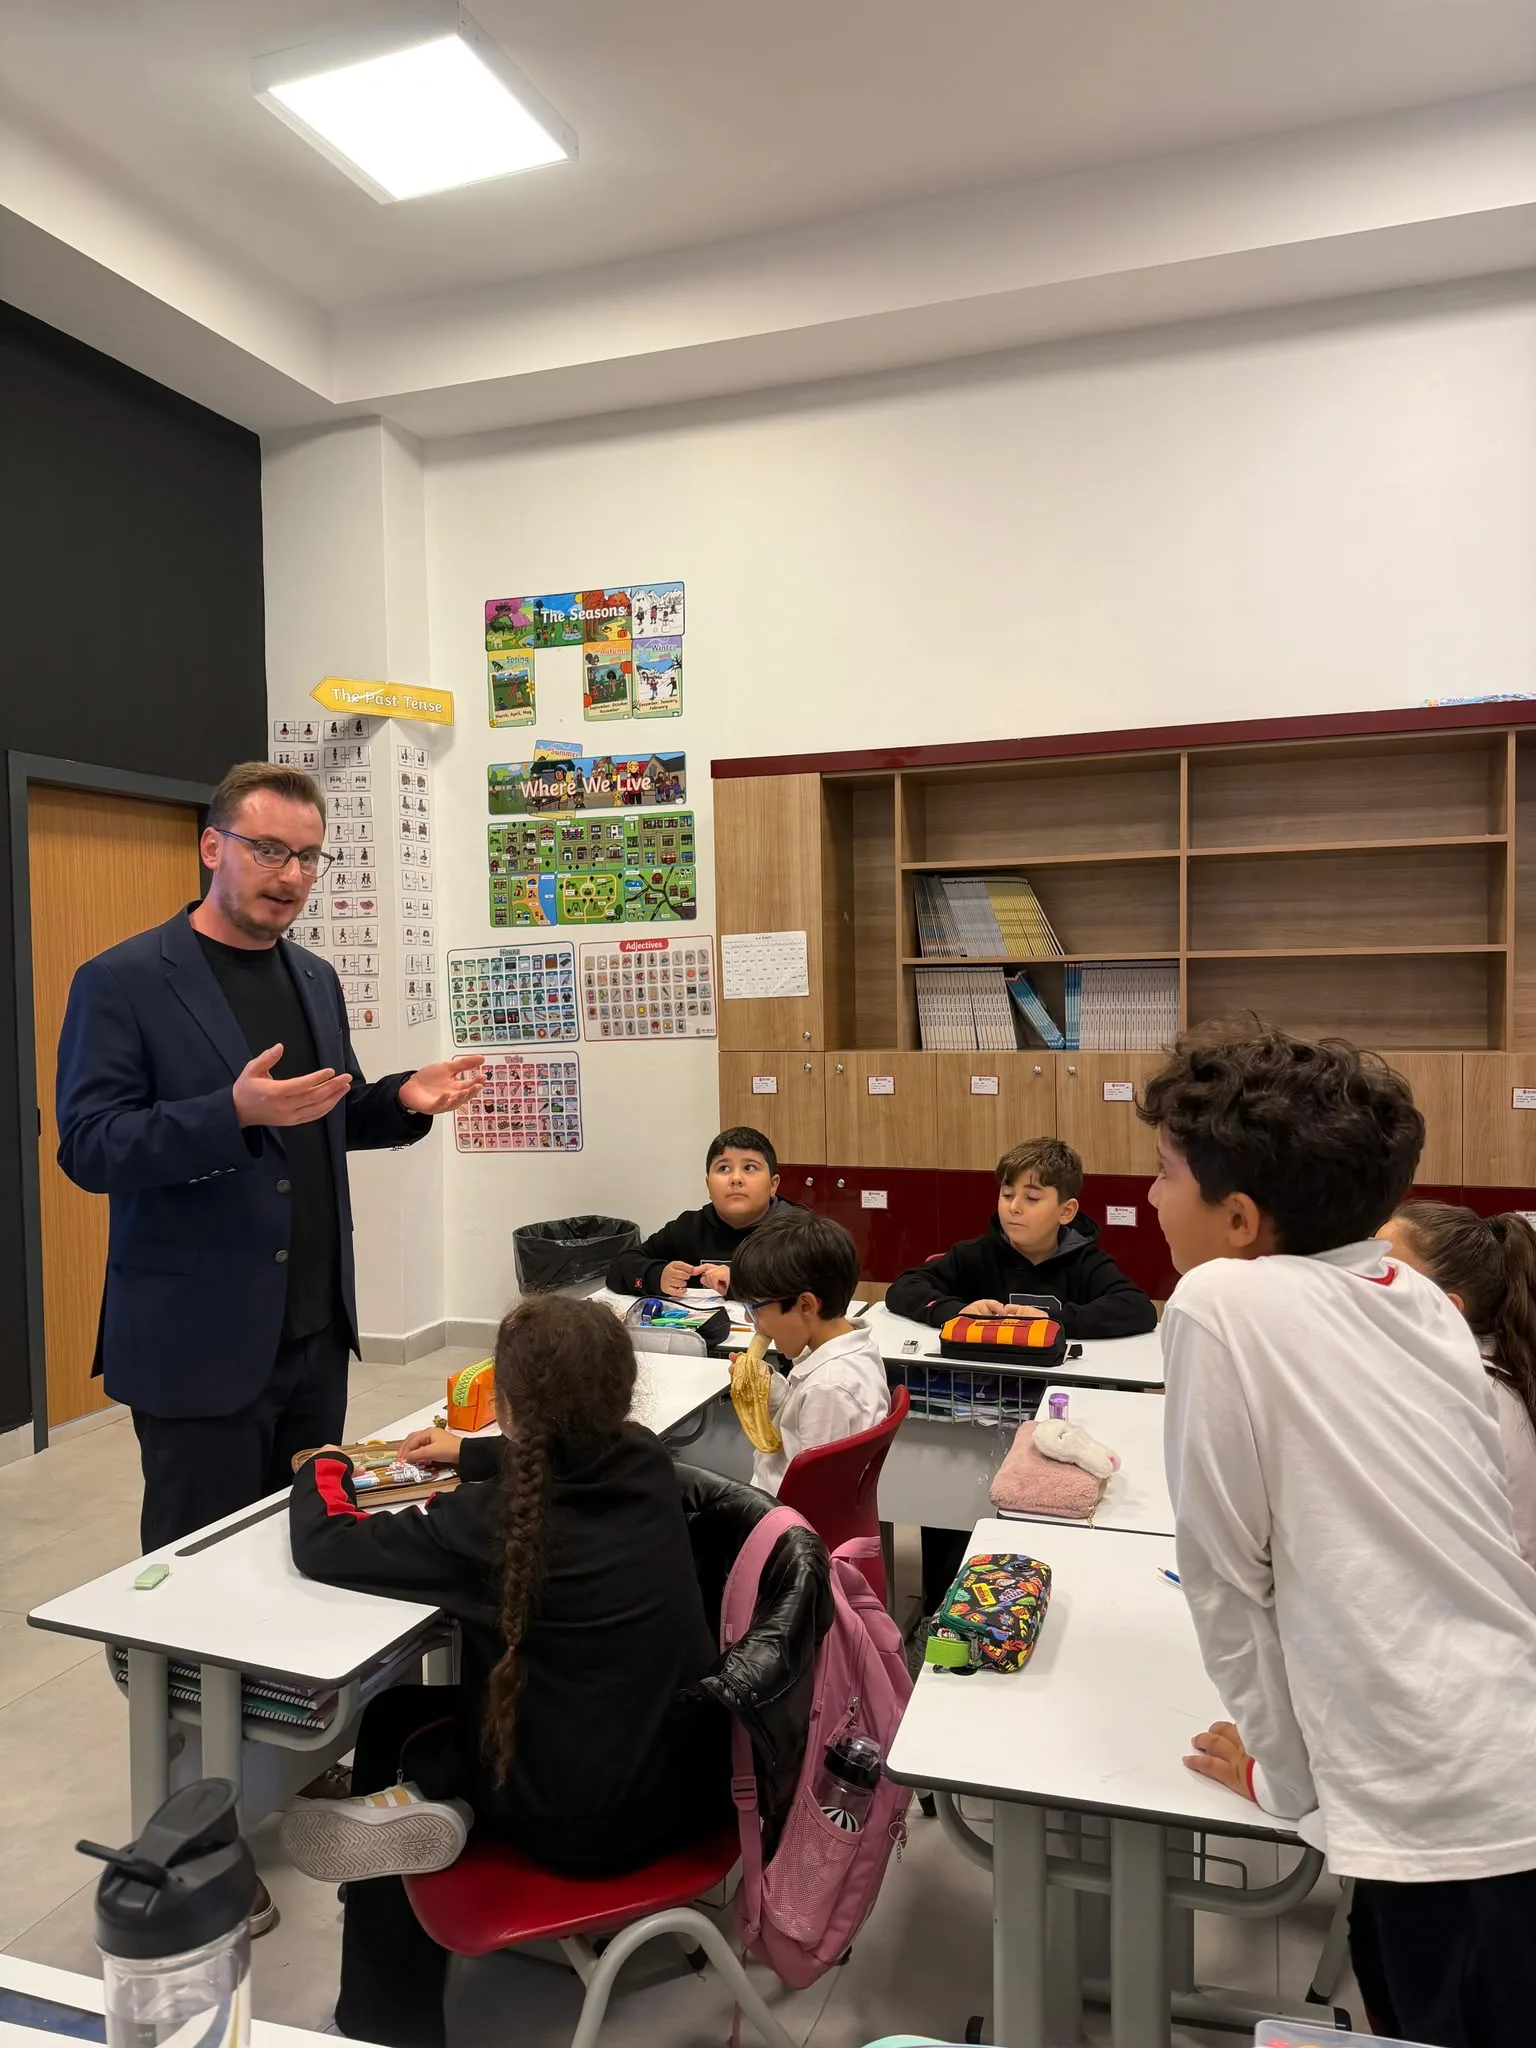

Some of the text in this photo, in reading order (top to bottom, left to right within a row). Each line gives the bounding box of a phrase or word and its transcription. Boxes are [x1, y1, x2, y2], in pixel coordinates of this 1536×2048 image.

[541, 606, 625, 623] The Seasons
[600, 647, 629, 655] Autumn
[652, 643, 677, 652] Winter
[506, 655, 529, 664] Spring
[331, 688, 443, 713] The Past Tense
[550, 748, 579, 757] Summer
[520, 774, 651, 798] Where We Live
[625, 940, 663, 951] Adjectives
